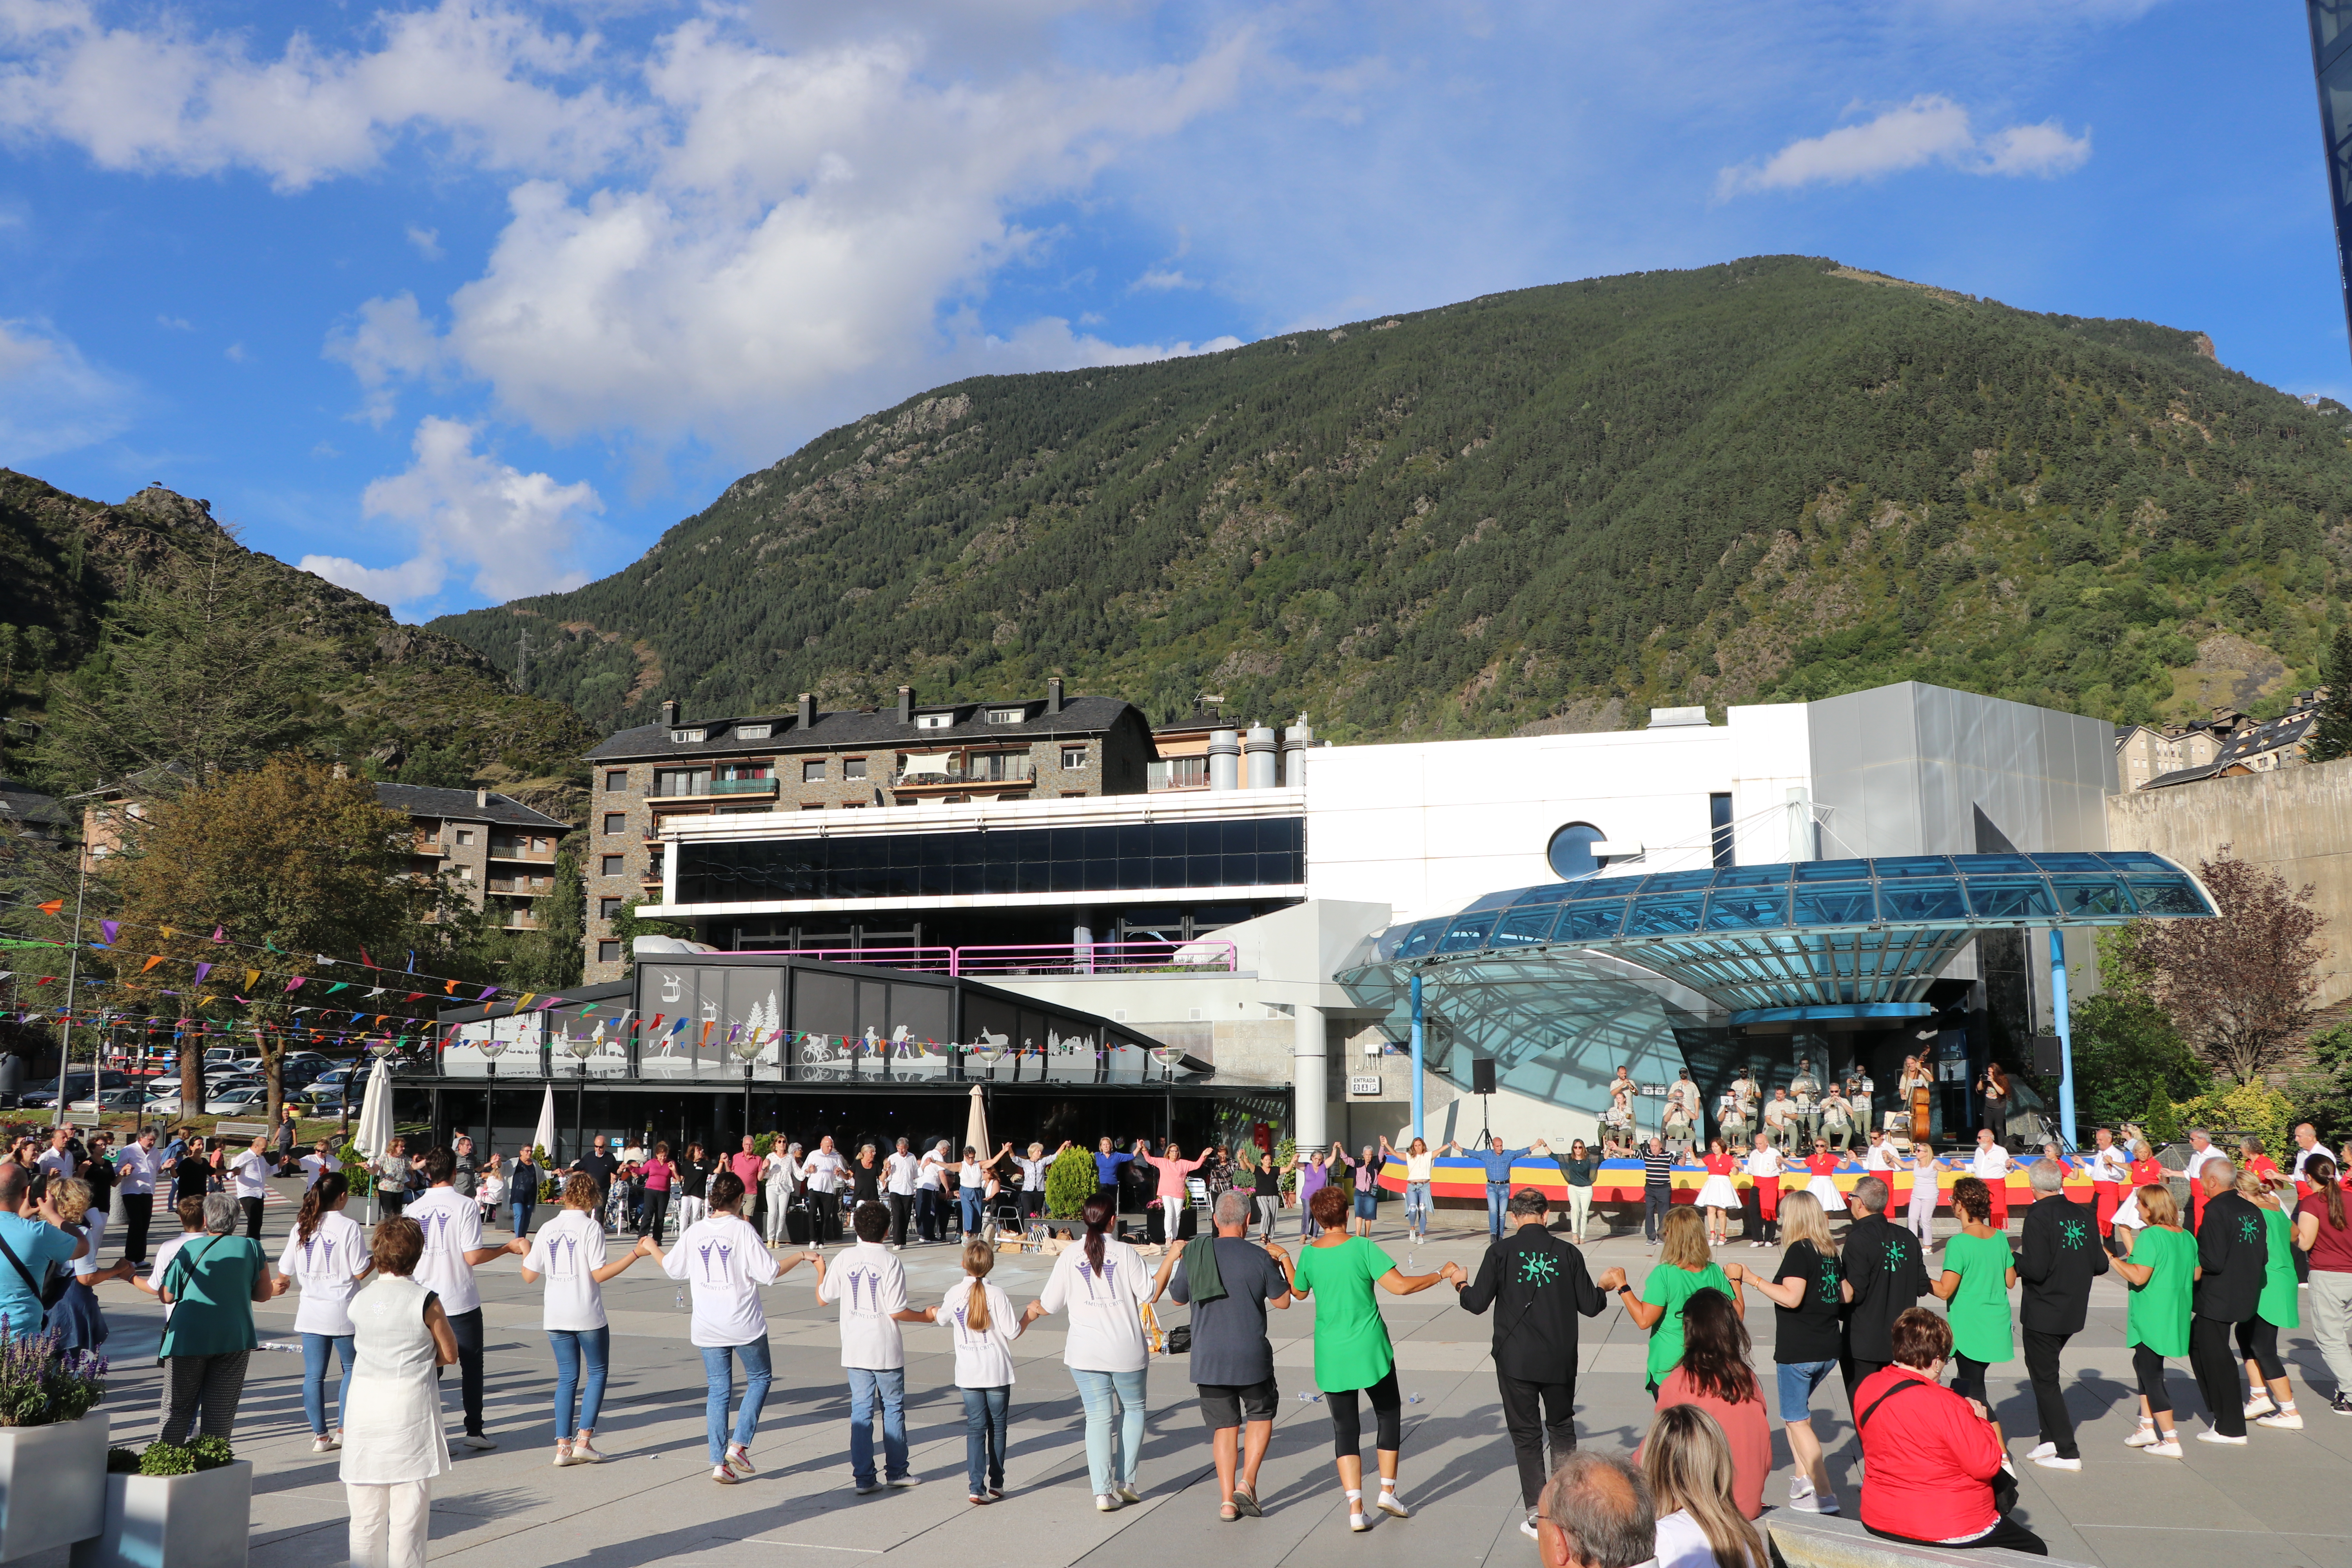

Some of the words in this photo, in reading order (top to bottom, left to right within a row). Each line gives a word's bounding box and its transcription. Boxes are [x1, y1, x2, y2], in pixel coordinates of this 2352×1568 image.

[1074, 1252, 1086, 1262] COLLE
[299, 1272, 317, 1280] AMUNT
[699, 1281, 717, 1290] AMUNT
[1109, 1298, 1124, 1308] CRITS
[870, 1311, 884, 1319] CRITS
[980, 1342, 995, 1350] CRITS
